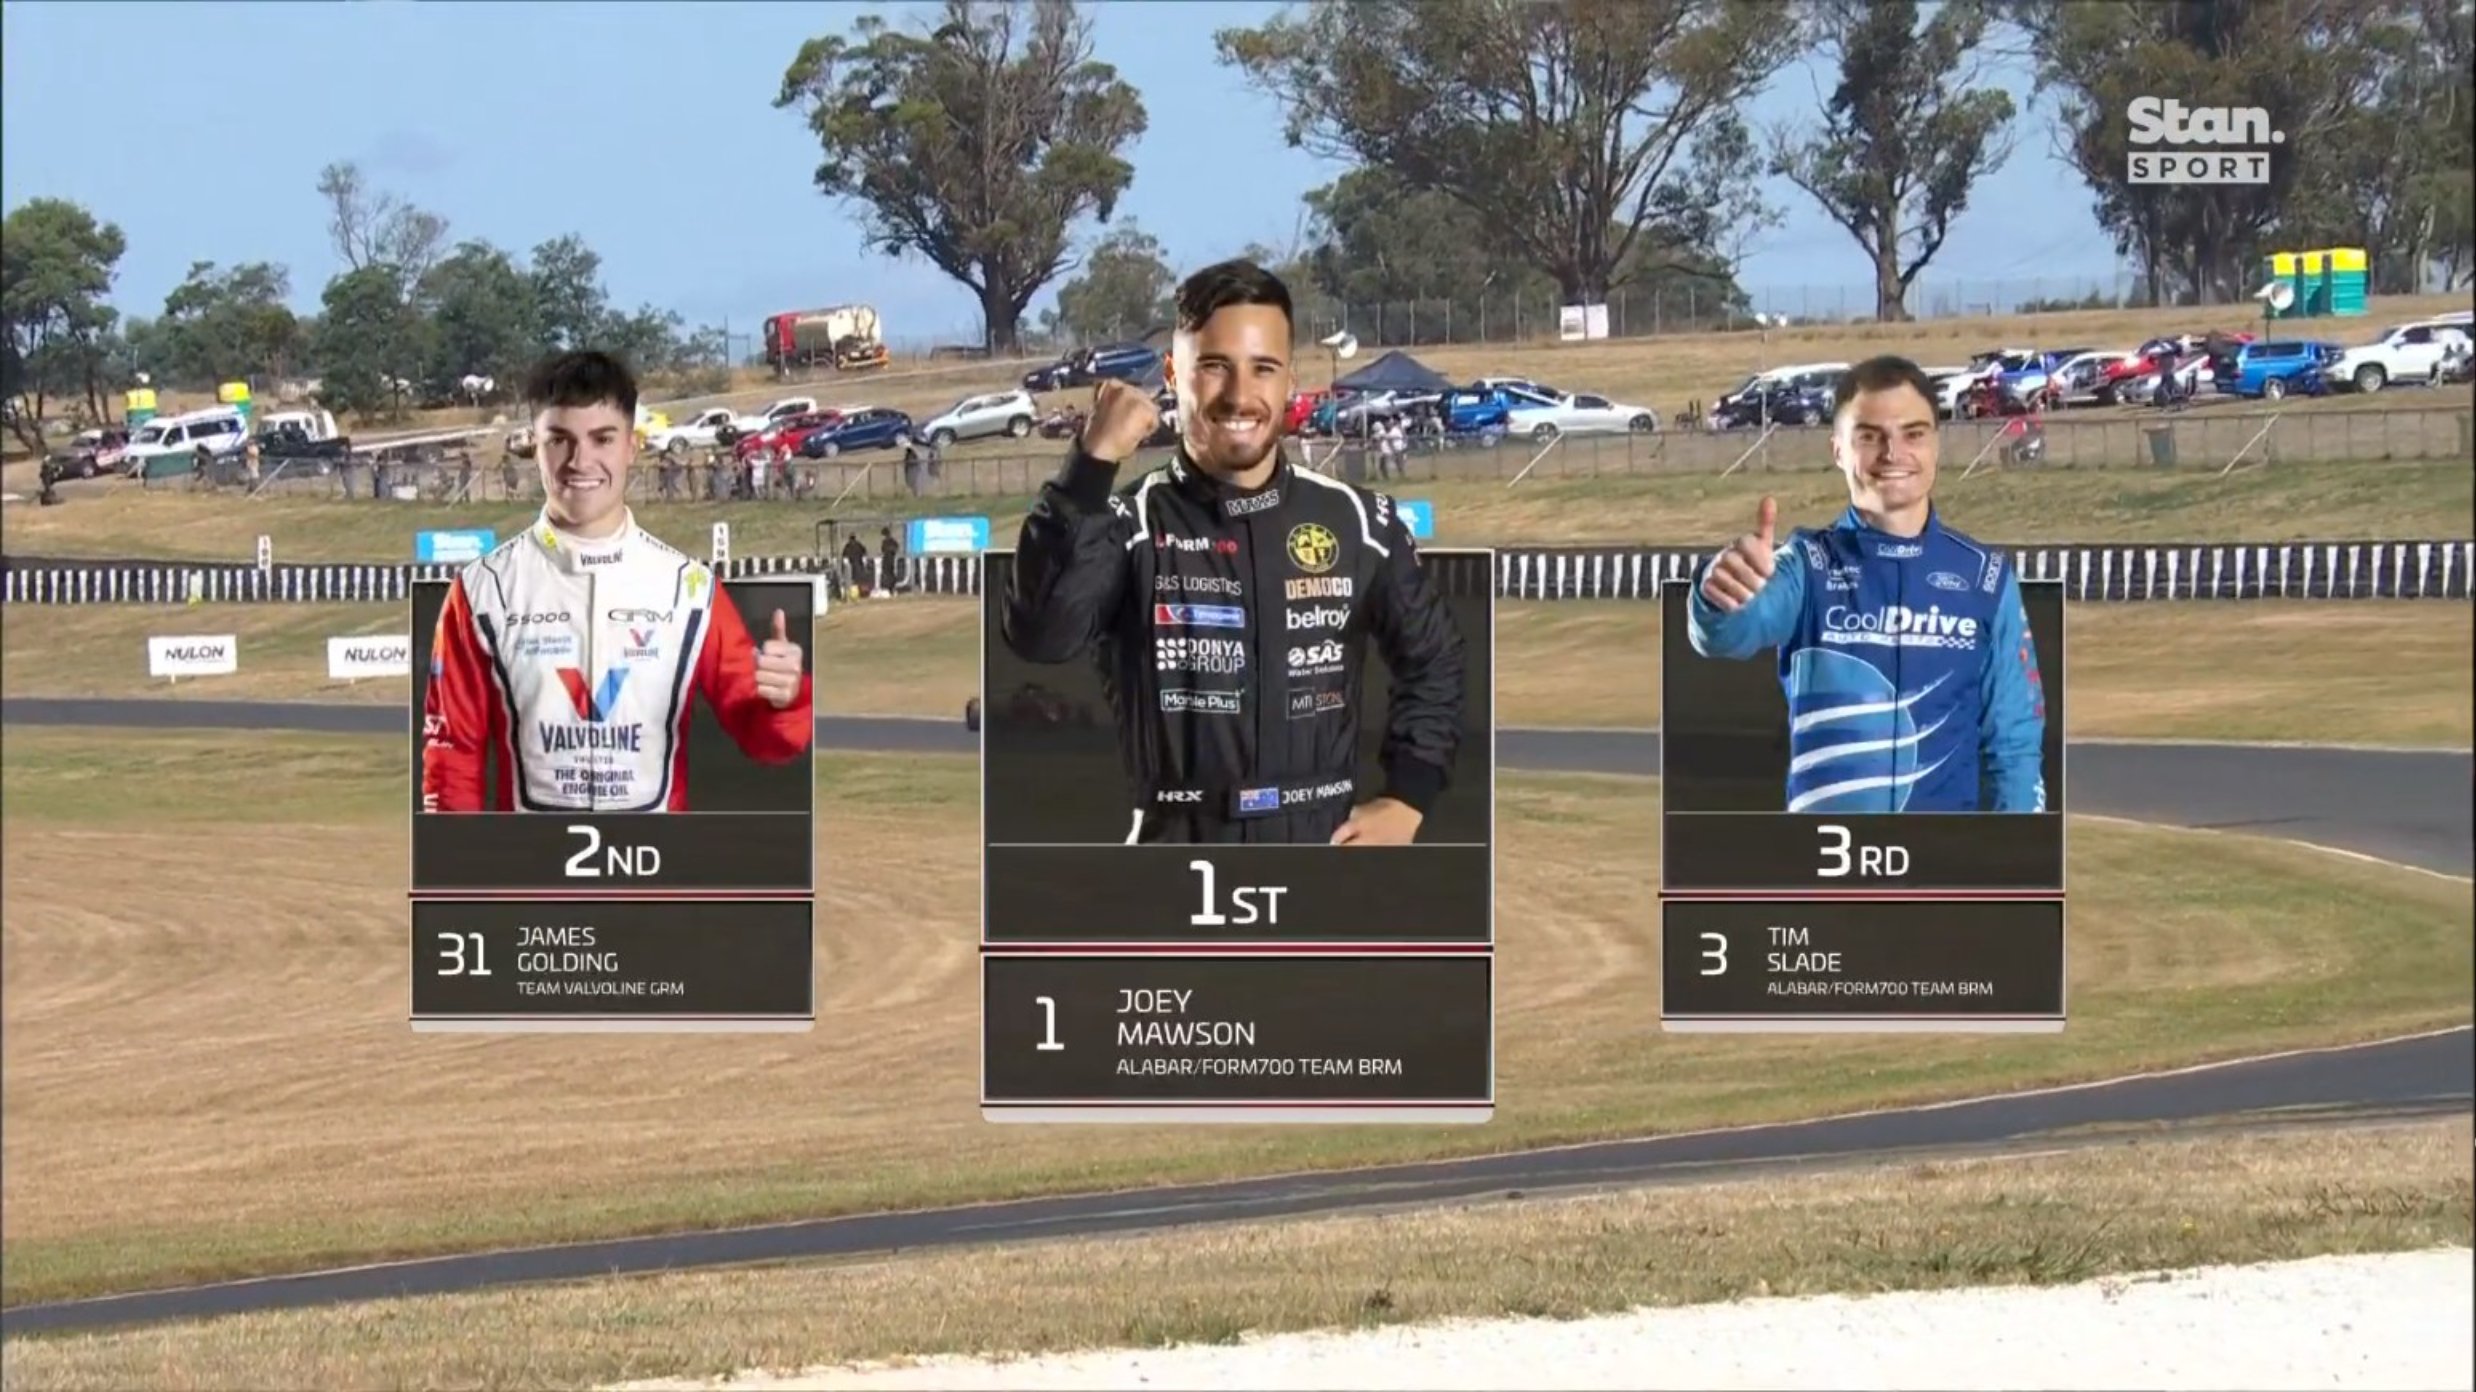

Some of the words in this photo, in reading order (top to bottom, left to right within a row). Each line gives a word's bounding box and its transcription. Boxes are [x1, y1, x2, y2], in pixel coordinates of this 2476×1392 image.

[1285, 577, 1352, 600] DEMOCO
[1286, 604, 1351, 631] belroy
[1826, 605, 1977, 637] CoolDrive
[165, 645, 225, 660] NULON
[345, 646, 406, 662] NULON
[1189, 638, 1245, 657] DONYA
[1189, 655, 1245, 674] GROUP
[539, 720, 643, 754] VALVOLINE
[554, 769, 577, 781] THE
[609, 784, 629, 796] OIL
[1157, 790, 1204, 802] HRX
[1282, 788, 1313, 804] JOEY
[1316, 778, 1354, 798] MAWSON
